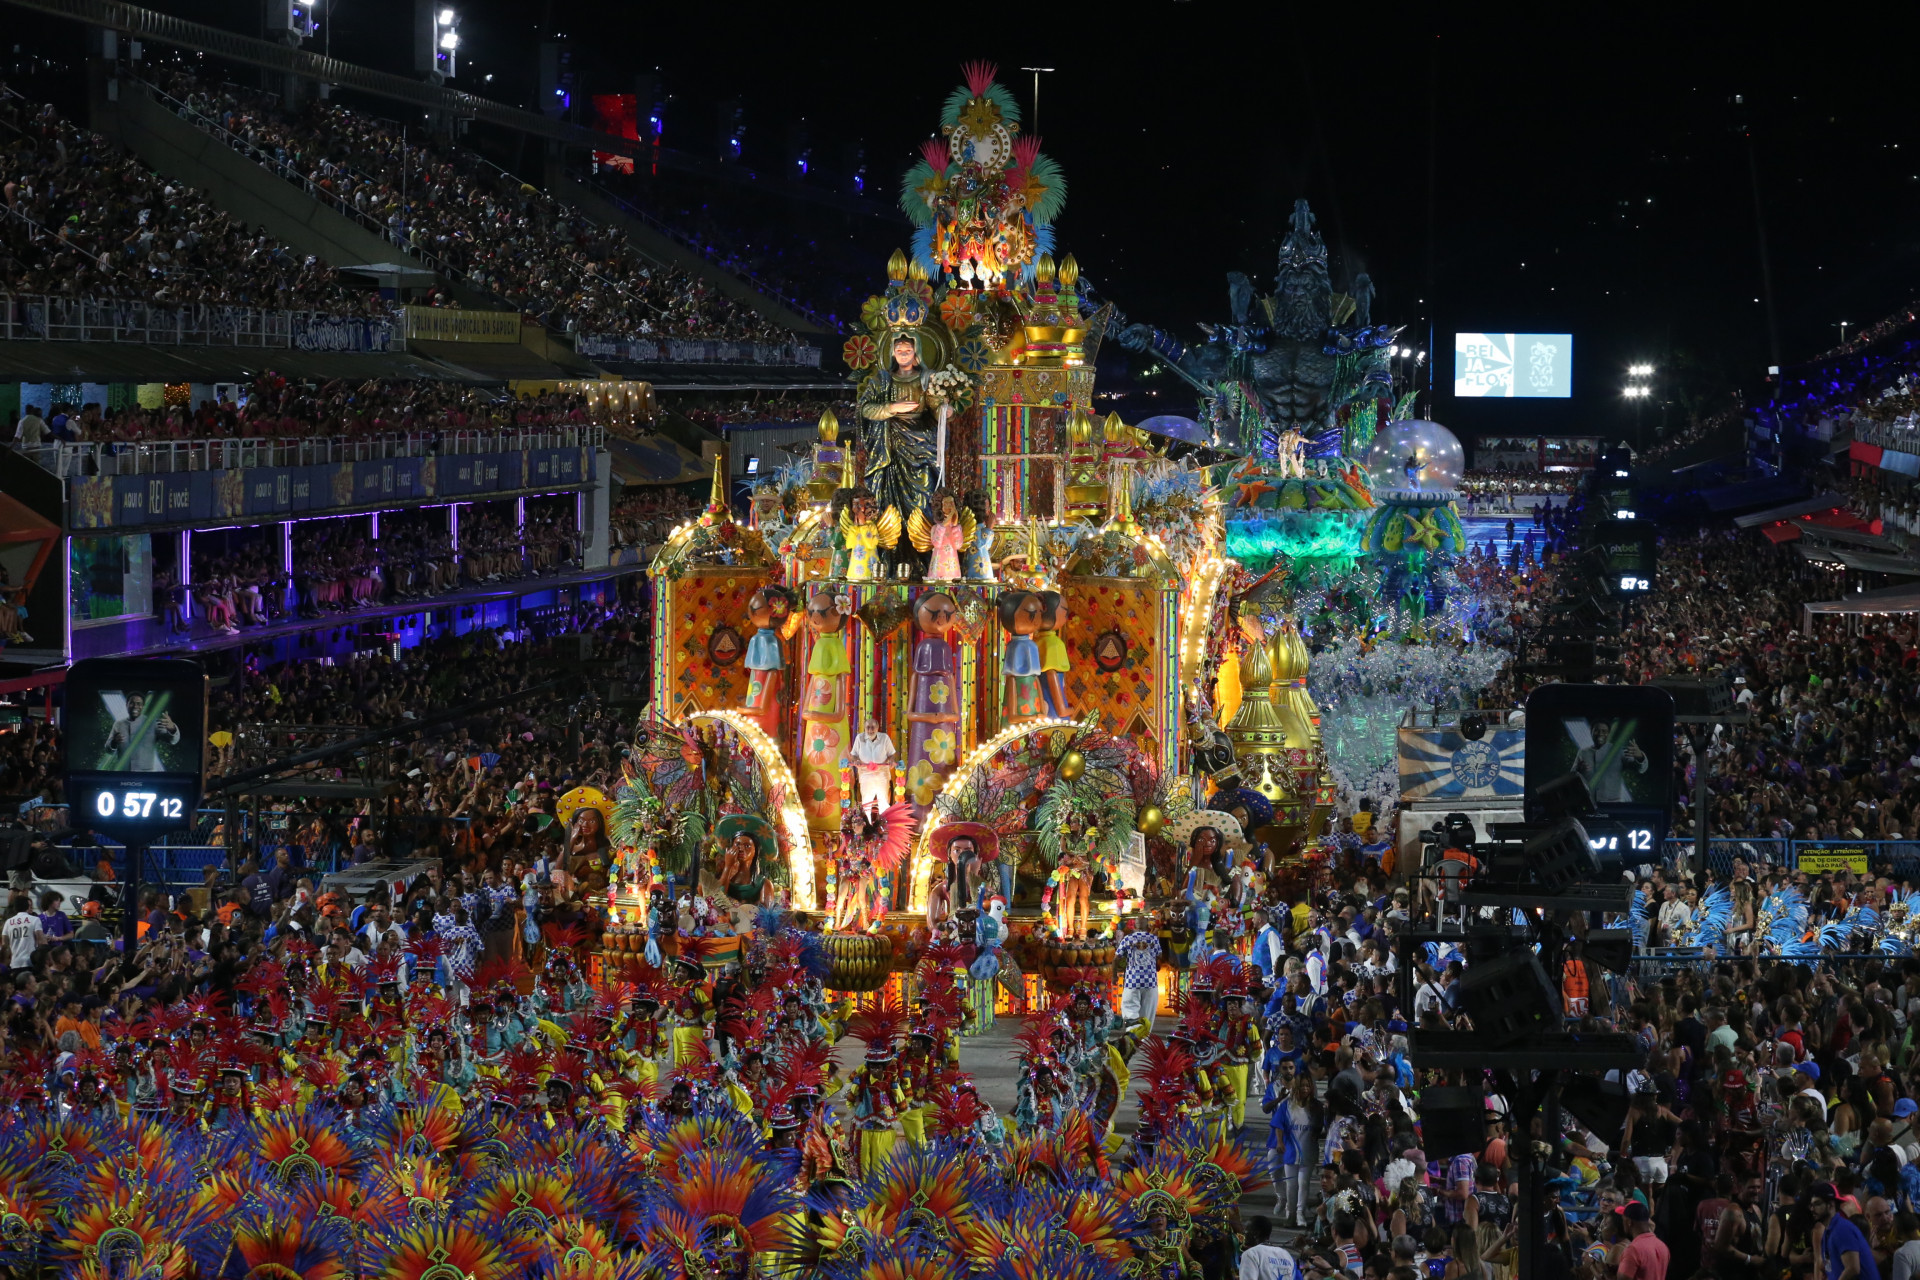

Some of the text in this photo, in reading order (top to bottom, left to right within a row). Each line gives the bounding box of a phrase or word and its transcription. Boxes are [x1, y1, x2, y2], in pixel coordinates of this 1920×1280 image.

[482, 319, 490, 334] DA
[1465, 372, 1511, 387] FLOR
[382, 464, 394, 493] REI
[123, 492, 138, 508] AQUI
[138, 492, 143, 507] O
[149, 479, 164, 514] REI
[276, 474, 289, 505] REI
[1620, 577, 1649, 590] 57 12
[1479, 764, 1499, 786] FLOR
[97, 791, 182, 818] 0 57 12
[1627, 829, 1651, 850] 12
[12, 926, 29, 939] 012
